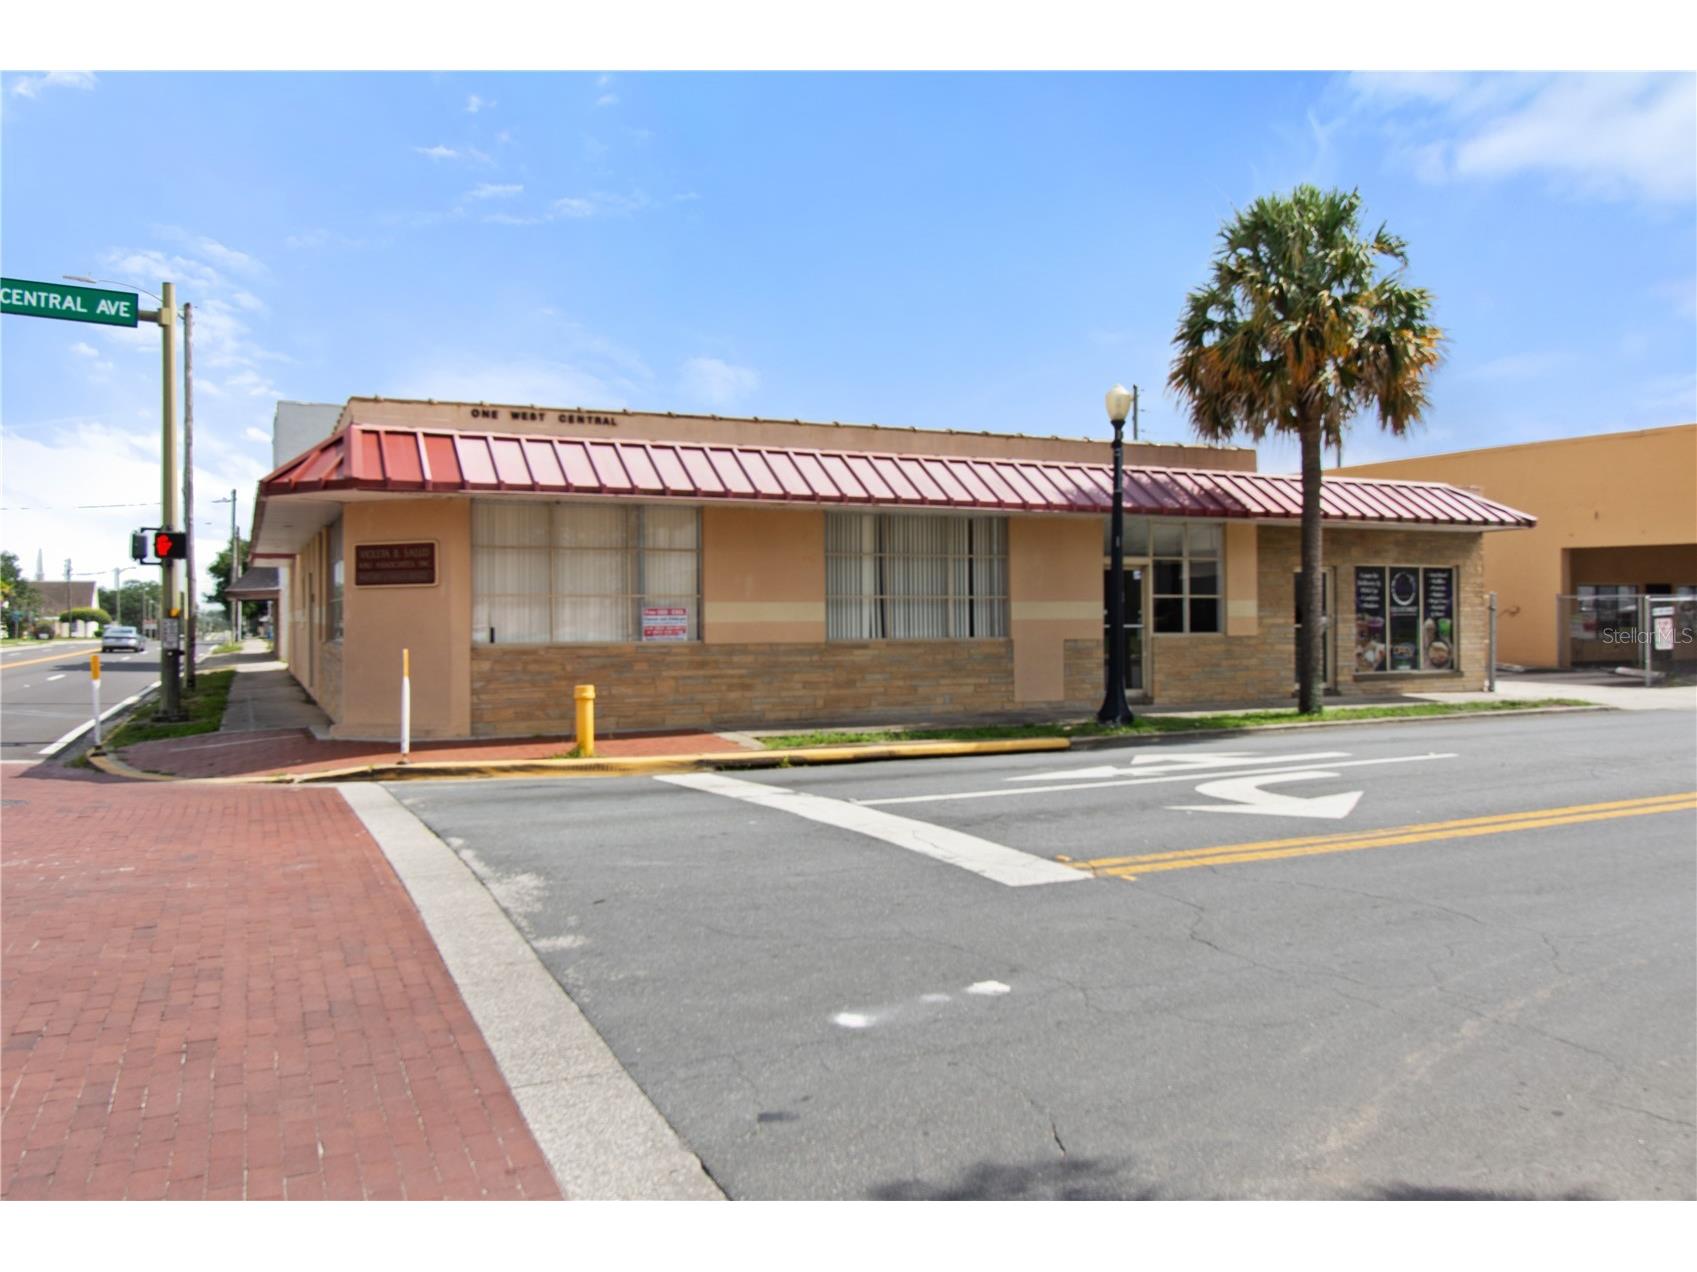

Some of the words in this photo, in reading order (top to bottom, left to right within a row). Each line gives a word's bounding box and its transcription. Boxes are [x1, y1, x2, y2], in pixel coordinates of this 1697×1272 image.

[0, 288, 88, 313] CENTRAL
[96, 299, 131, 318] AVE
[471, 408, 499, 420] ONE
[511, 411, 545, 422] WEST
[558, 414, 618, 427] CENTRAL
